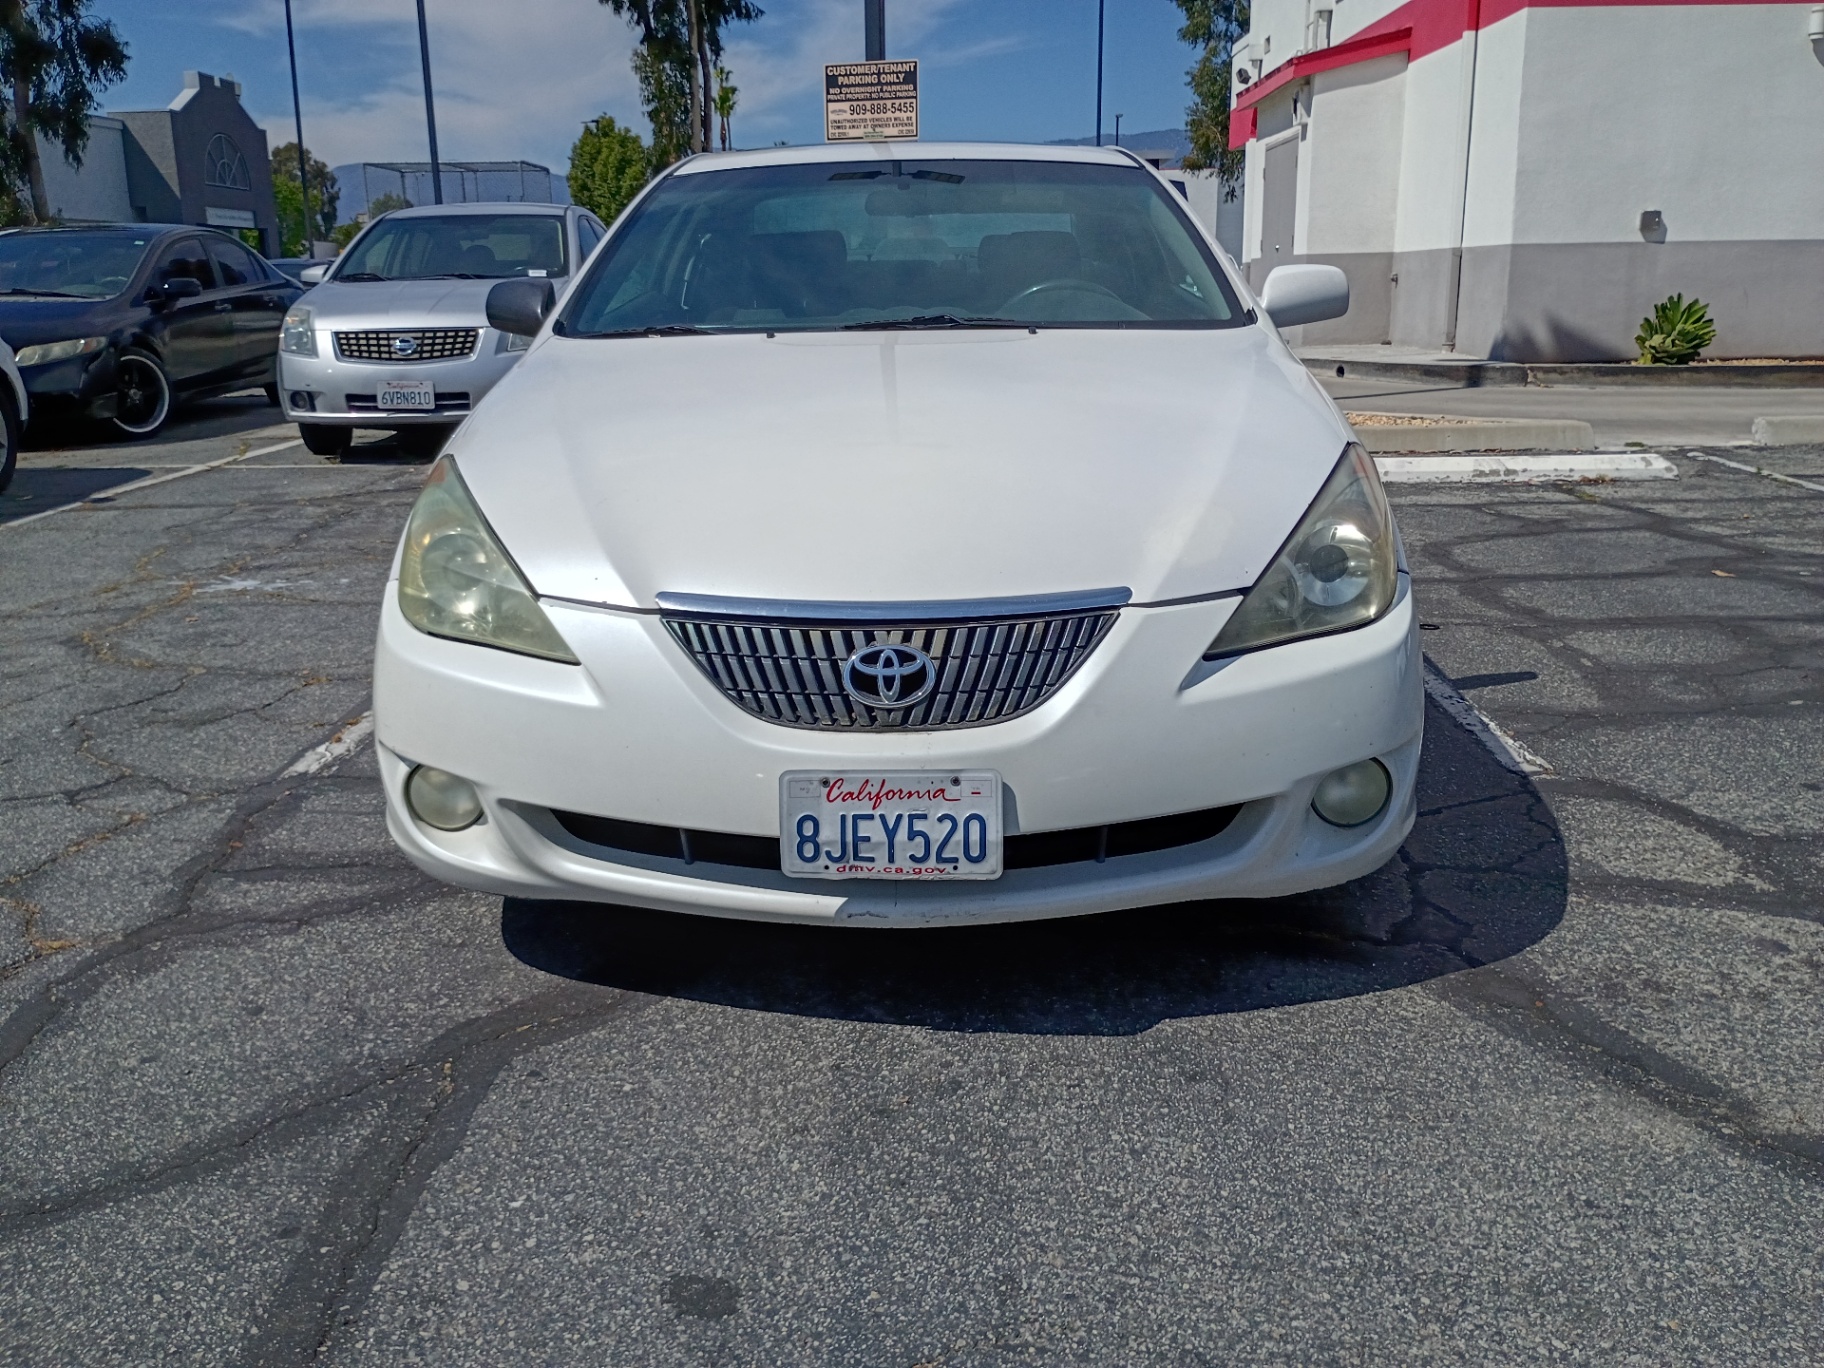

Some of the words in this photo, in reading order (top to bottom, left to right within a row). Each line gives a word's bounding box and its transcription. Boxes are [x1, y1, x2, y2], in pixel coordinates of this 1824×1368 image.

[827, 63, 915, 76] CUSTOMER/TENANT
[838, 75, 878, 85] PARKING
[880, 73, 905, 82] ONLY
[849, 102, 914, 115] 909-888-5455
[382, 391, 430, 405] 6VBN810
[826, 778, 961, 810] California
[796, 813, 986, 864] 8JEY520
[836, 865, 946, 875] dmv.ca.gov
